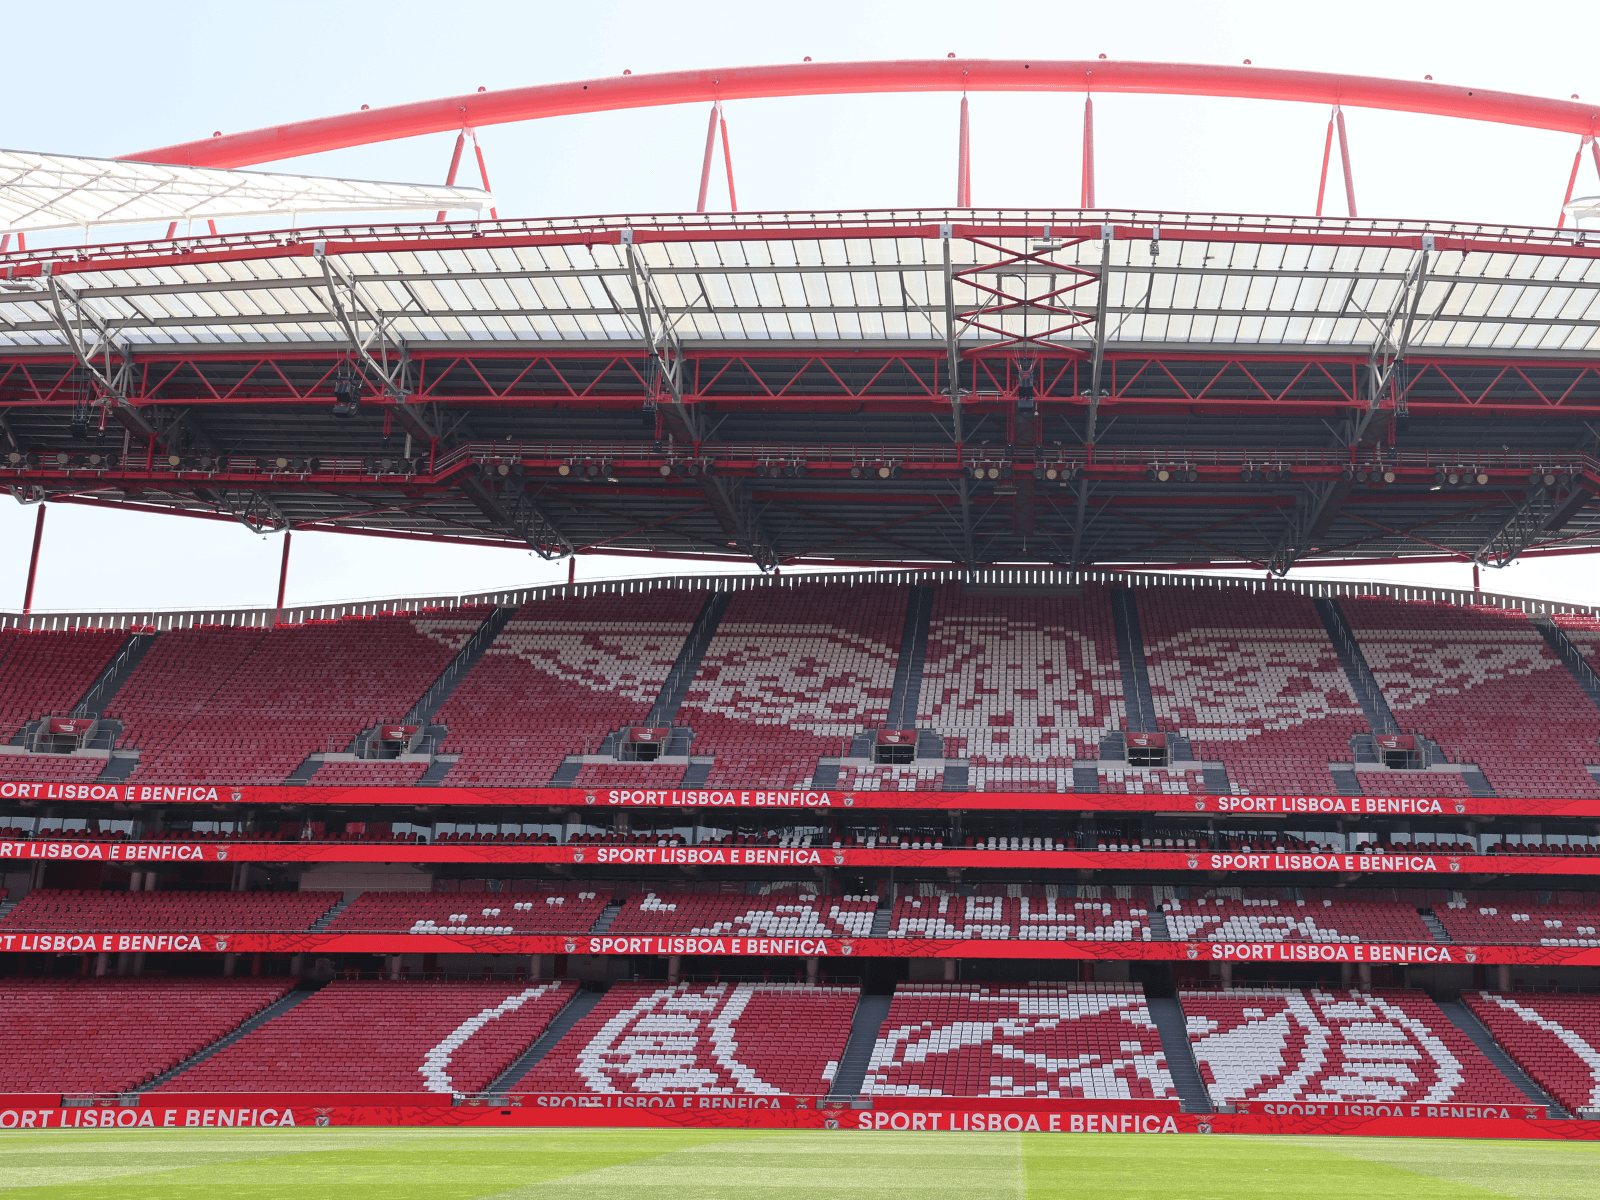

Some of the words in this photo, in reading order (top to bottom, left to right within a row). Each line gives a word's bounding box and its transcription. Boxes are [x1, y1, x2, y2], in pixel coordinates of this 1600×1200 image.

[48, 785, 118, 799] LISBOA
[126, 787, 135, 800] E
[141, 787, 218, 801] BENFICA
[609, 790, 667, 804] SPORT
[672, 791, 735, 806] LISBOA
[741, 792, 749, 805] E
[756, 792, 831, 807] BENFICA
[1218, 796, 1277, 811] SPORT
[1282, 797, 1346, 812] LISBOA
[1351, 798, 1360, 811] E
[1366, 798, 1442, 813] BENFICA
[30, 844, 102, 859] LISBOA
[110, 846, 120, 859] E
[126, 845, 203, 860] BENFICA
[597, 848, 656, 863] SPORT
[661, 848, 725, 864] LISBOA
[731, 849, 739, 863] E
[745, 849, 821, 865] BENFICA
[1211, 854, 1270, 869] SPORT
[1275, 855, 1340, 870] LISBOA
[1345, 856, 1354, 869] E
[1360, 856, 1437, 871] BENFICA
[21, 935, 96, 951] LISBOA
[103, 936, 113, 950] E
[119, 935, 201, 951] BENFICA
[590, 937, 652, 952] SPORT
[658, 937, 725, 954] LISBOA
[732, 938, 740, 953] E
[747, 938, 827, 955] BENFICA
[1211, 943, 1274, 959] SPORT
[1280, 944, 1349, 961] LISBOA
[1354, 945, 1363, 960] E
[1370, 945, 1451, 962] BENFICA
[61, 1109, 155, 1128] LISBOA
[164, 1109, 176, 1127] E
[186, 1108, 295, 1127] BENFICA
[1264, 1104, 1329, 1115] SPORT
[858, 1111, 945, 1130] SPORT
[950, 1112, 1041, 1132] LISBOA
[1050, 1114, 1061, 1132] E
[1071, 1114, 1179, 1134] BENFICA
